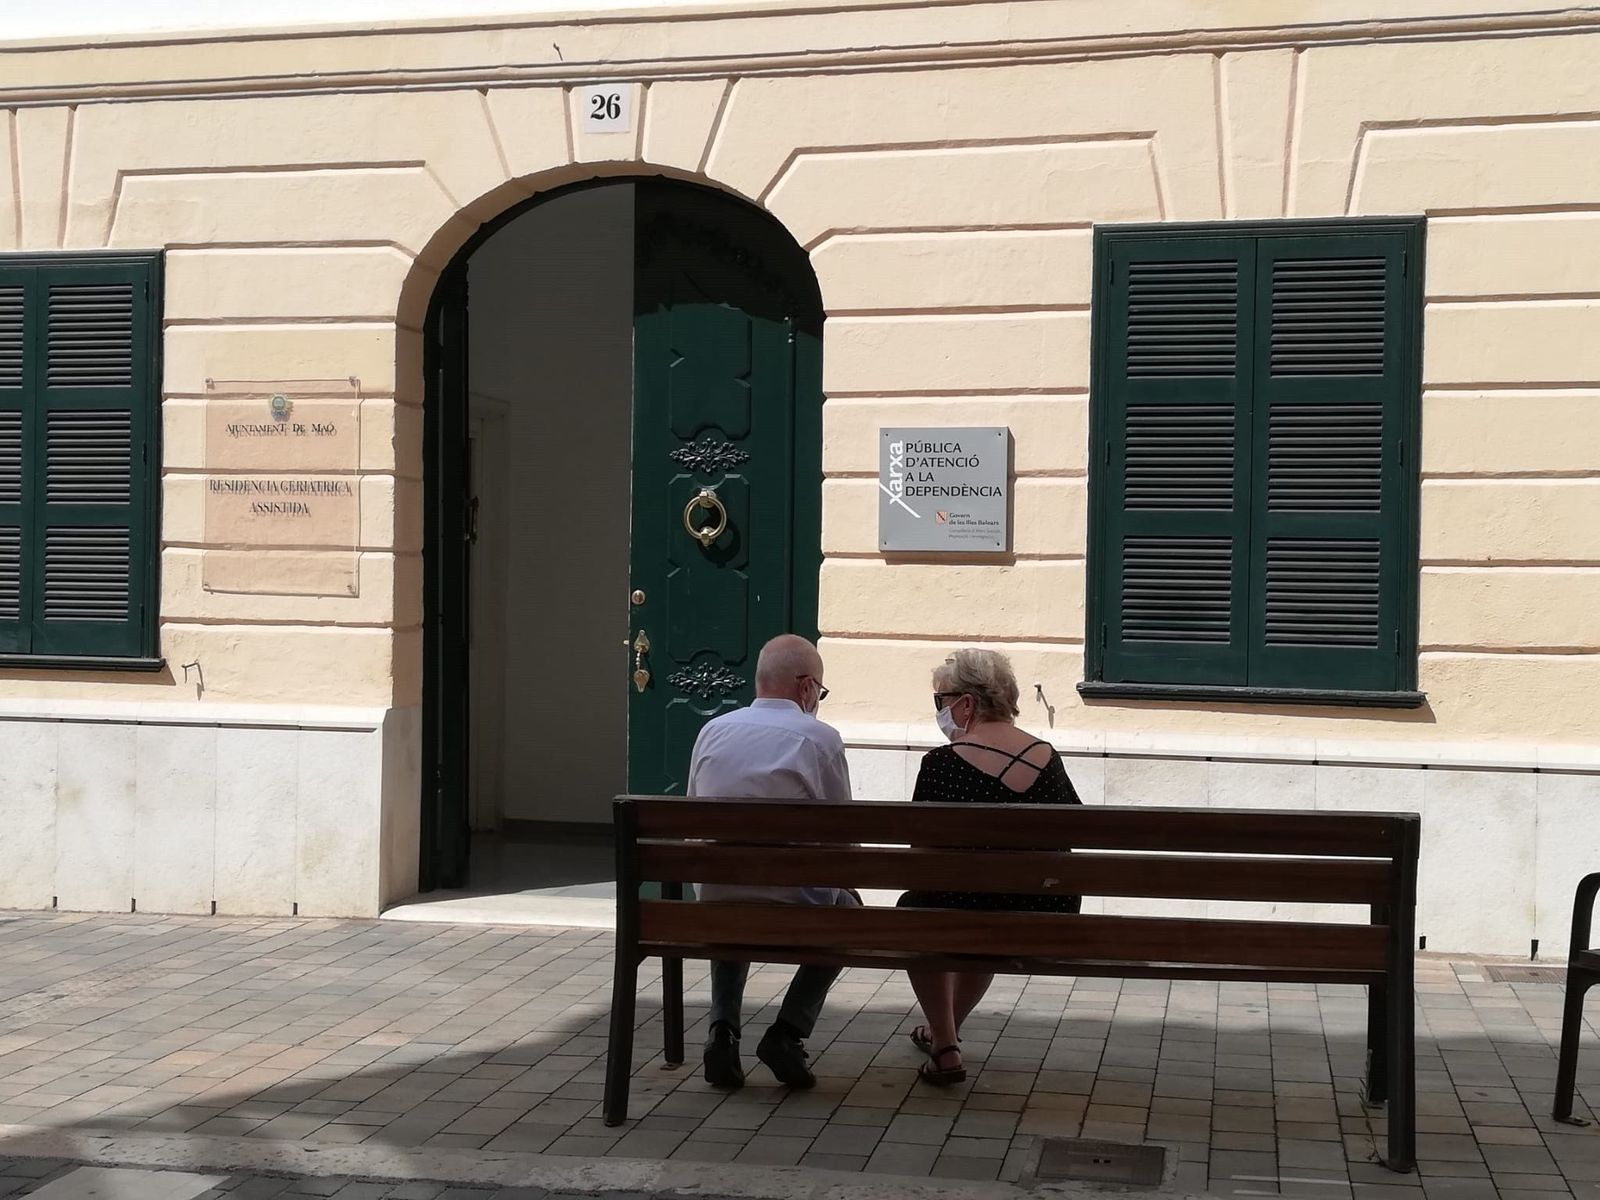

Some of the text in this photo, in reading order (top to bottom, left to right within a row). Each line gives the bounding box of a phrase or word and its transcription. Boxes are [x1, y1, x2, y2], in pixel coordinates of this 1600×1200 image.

[590, 93, 621, 120] 26
[293, 423, 305, 432] DE
[905, 440, 962, 454] PÚBLICA
[905, 454, 980, 468] D'ATENCIÓ
[905, 472, 934, 482] A LA
[905, 483, 1002, 497] DEPENDÈNCIA
[249, 502, 308, 513] ASSISTIDA
